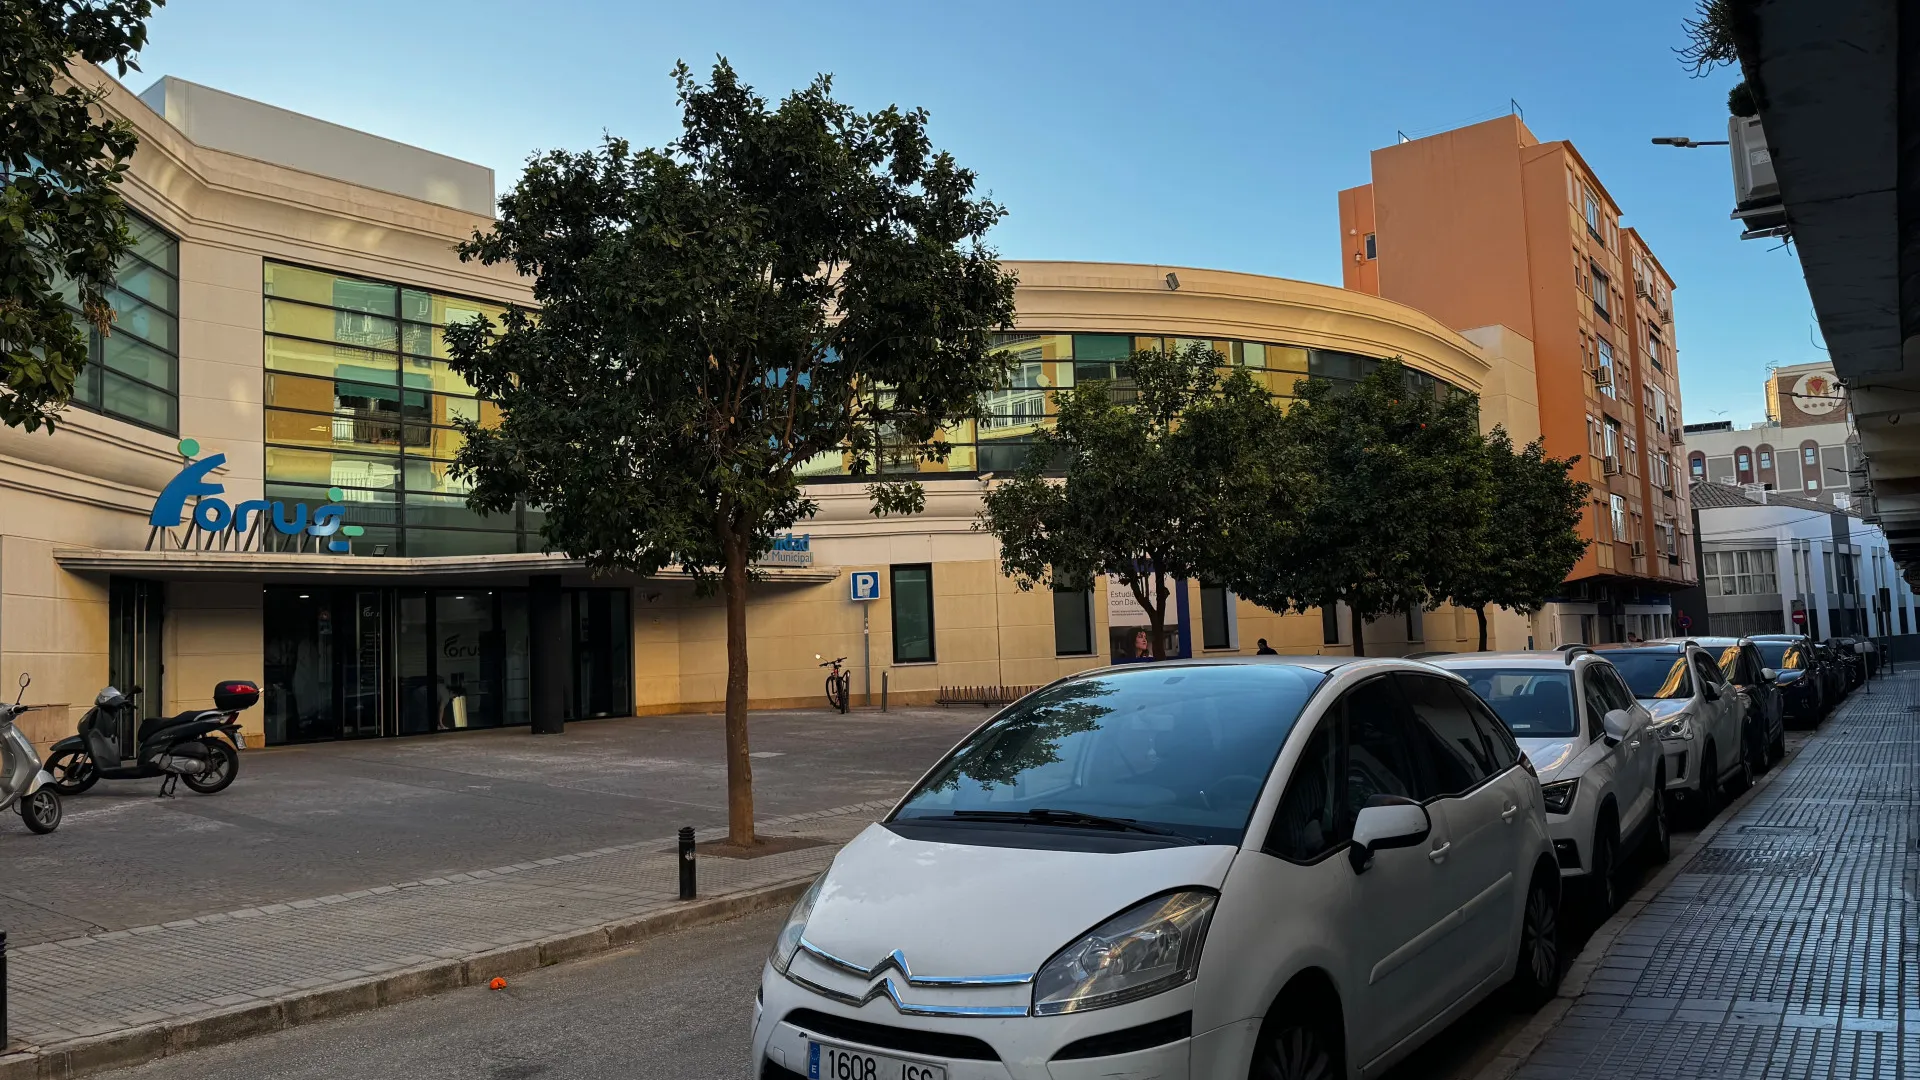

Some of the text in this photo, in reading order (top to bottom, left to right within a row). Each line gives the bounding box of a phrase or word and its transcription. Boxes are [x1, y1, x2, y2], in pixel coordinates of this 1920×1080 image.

[771, 551, 812, 563] Municipal
[856, 574, 874, 597] P
[828, 1050, 877, 1080] 1608
